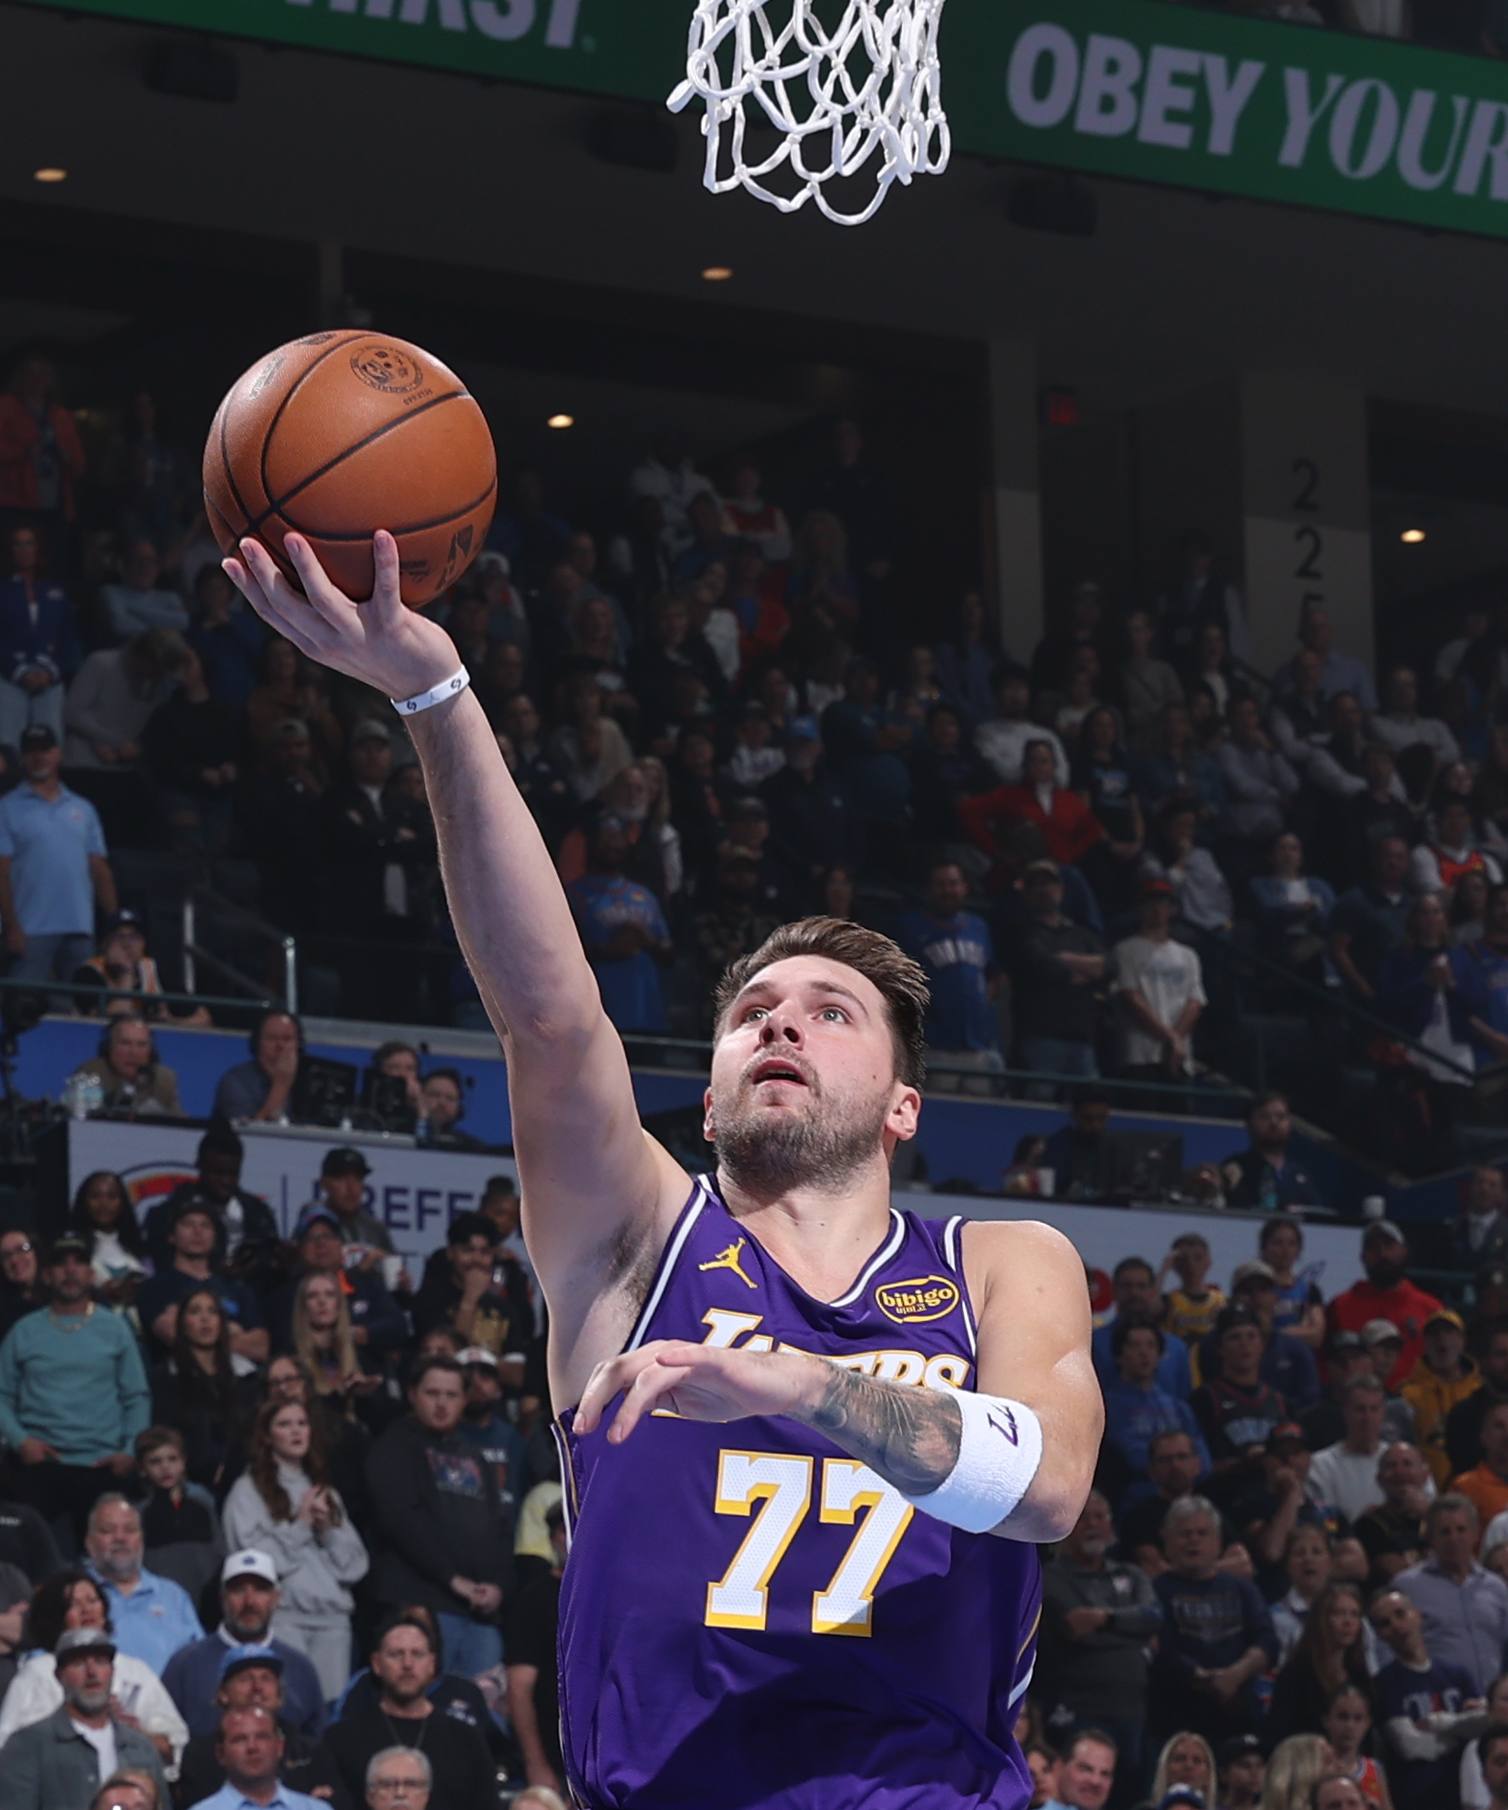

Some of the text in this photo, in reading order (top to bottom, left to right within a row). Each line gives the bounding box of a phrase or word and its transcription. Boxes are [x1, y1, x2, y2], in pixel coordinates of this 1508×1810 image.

[1006, 23, 1265, 156] OBEY
[882, 1288, 953, 1307] bibigo
[705, 1449, 915, 1639] 77
